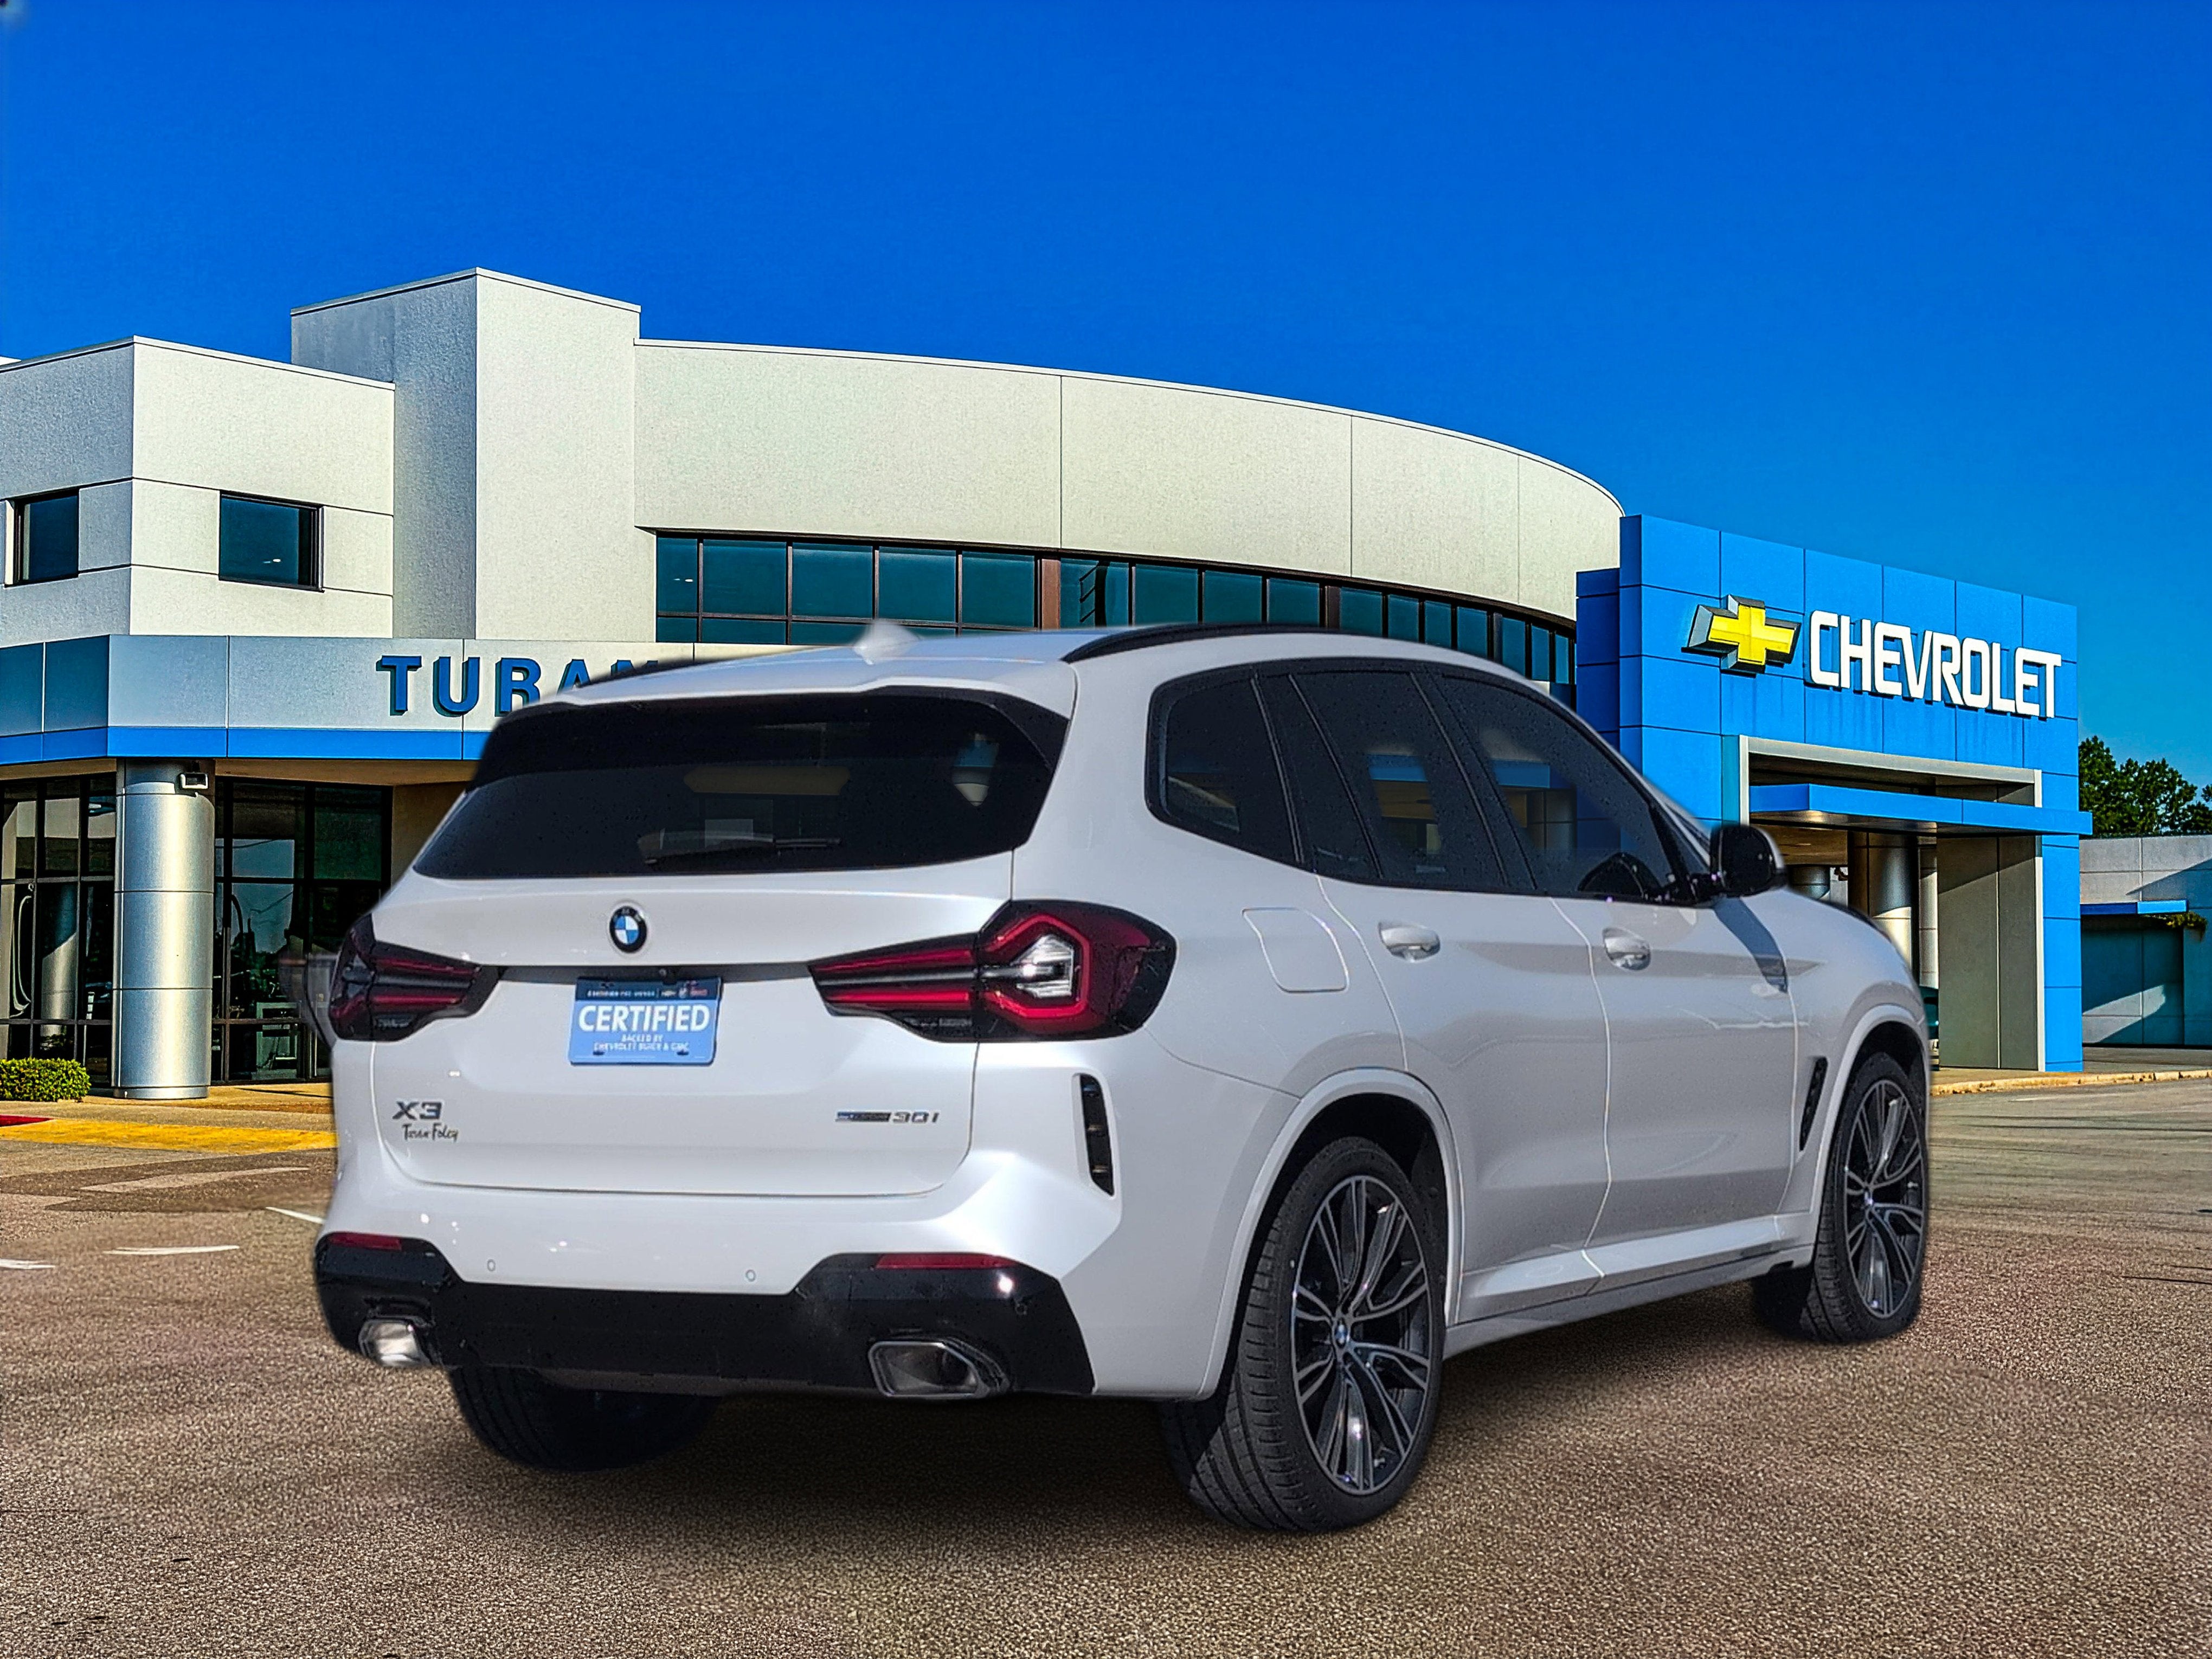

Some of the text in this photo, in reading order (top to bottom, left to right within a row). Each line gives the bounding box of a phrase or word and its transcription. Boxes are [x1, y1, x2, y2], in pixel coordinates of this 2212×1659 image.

[376, 654, 658, 717] TURA
[1809, 609, 2062, 719] CHEVROLET
[578, 1005, 711, 1032] CERTIFIED
[392, 1101, 442, 1121] X3
